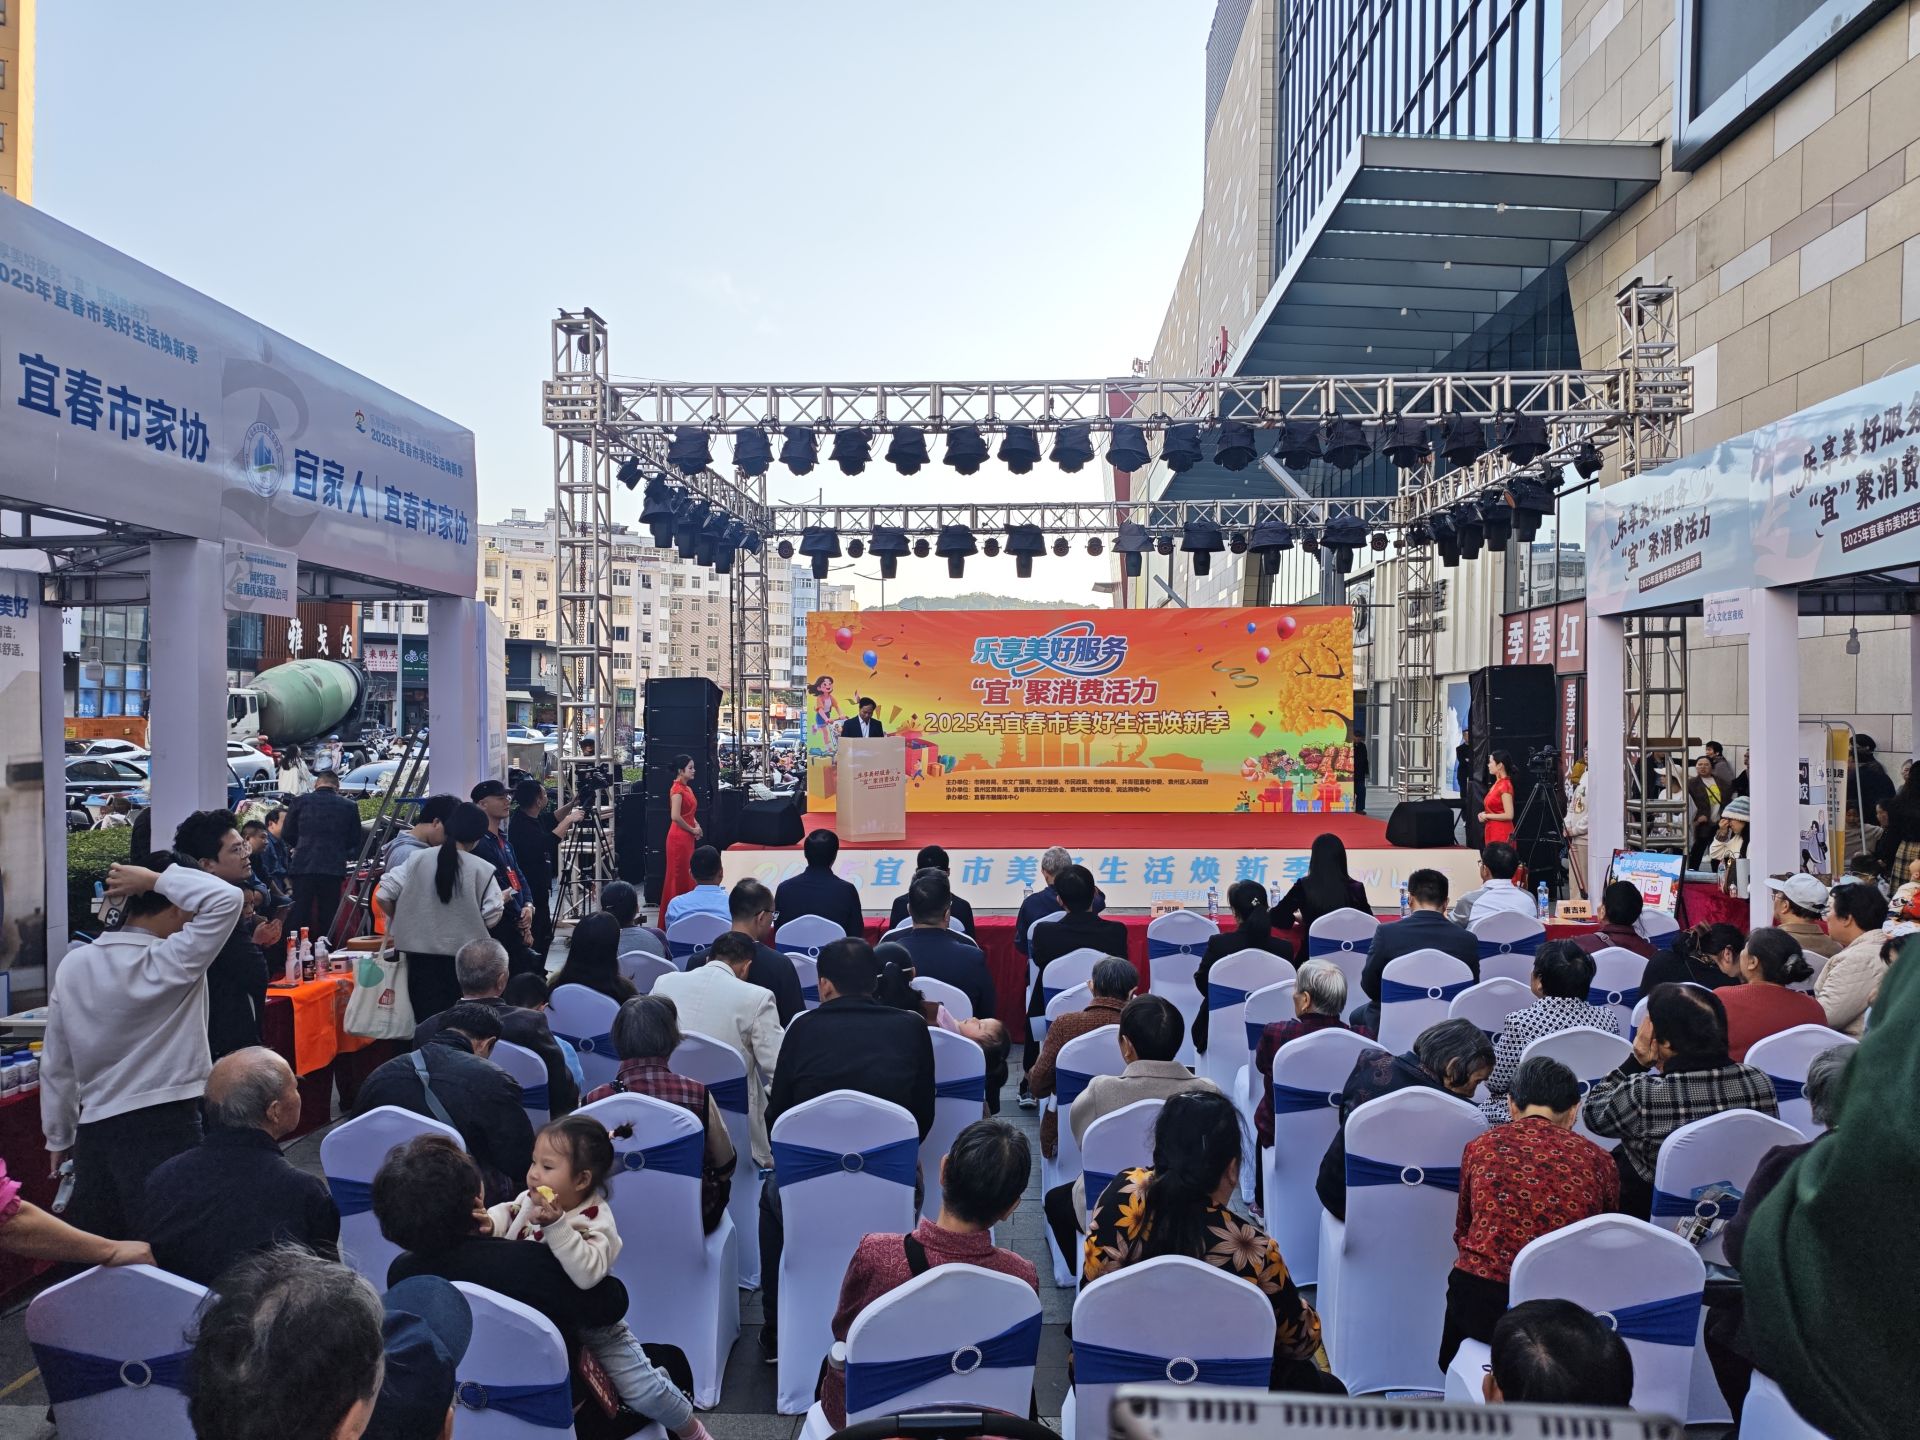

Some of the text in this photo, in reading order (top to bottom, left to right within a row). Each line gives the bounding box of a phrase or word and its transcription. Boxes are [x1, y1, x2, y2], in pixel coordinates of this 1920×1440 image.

[18, 352, 210, 464] 宜春市家协
[293, 448, 368, 518] 宜家人
[384, 484, 469, 545] 宜春市家协
[1622, 505, 1711, 572] “宜”聚消费活力
[288, 617, 352, 660] 雅戈尔
[972, 635, 1128, 676] 乐享美好服务
[1508, 614, 1580, 664] 季季红
[972, 678, 1158, 706] “宜”聚消费活力
[924, 711, 1230, 735] 2025年宜春市美好生活焕新季
[870, 856, 1311, 886] 宜市美生活焕新季
[1563, 906, 1587, 914] 唐吉祥
